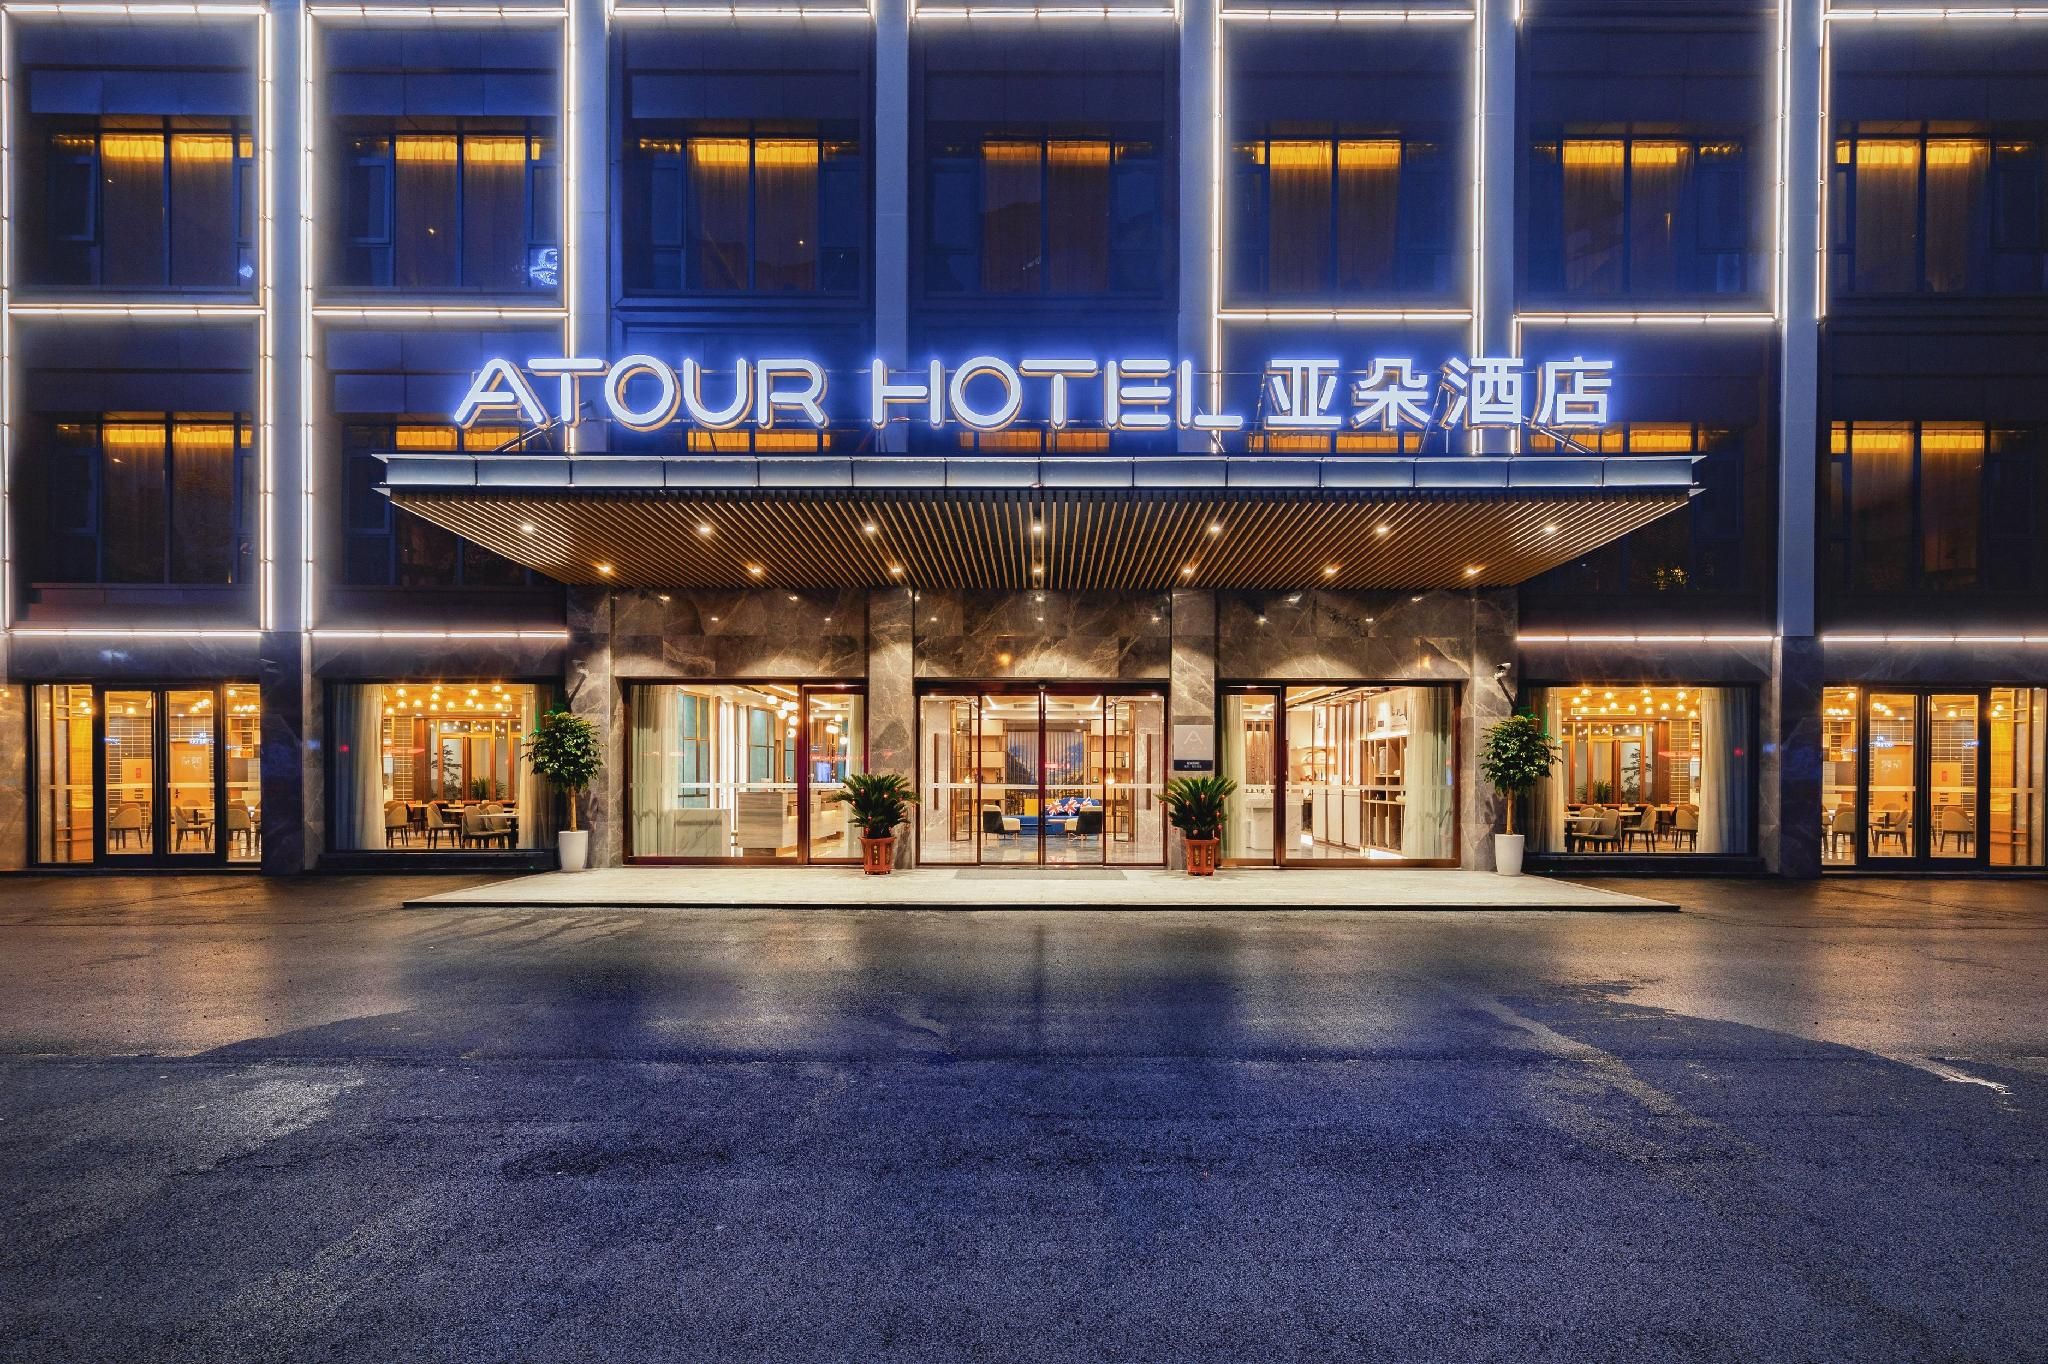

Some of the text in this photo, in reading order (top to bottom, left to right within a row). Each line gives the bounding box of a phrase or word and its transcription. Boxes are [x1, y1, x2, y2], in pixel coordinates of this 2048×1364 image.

[453, 354, 1615, 430] ATOUR HOTEL 亚朵酒店
